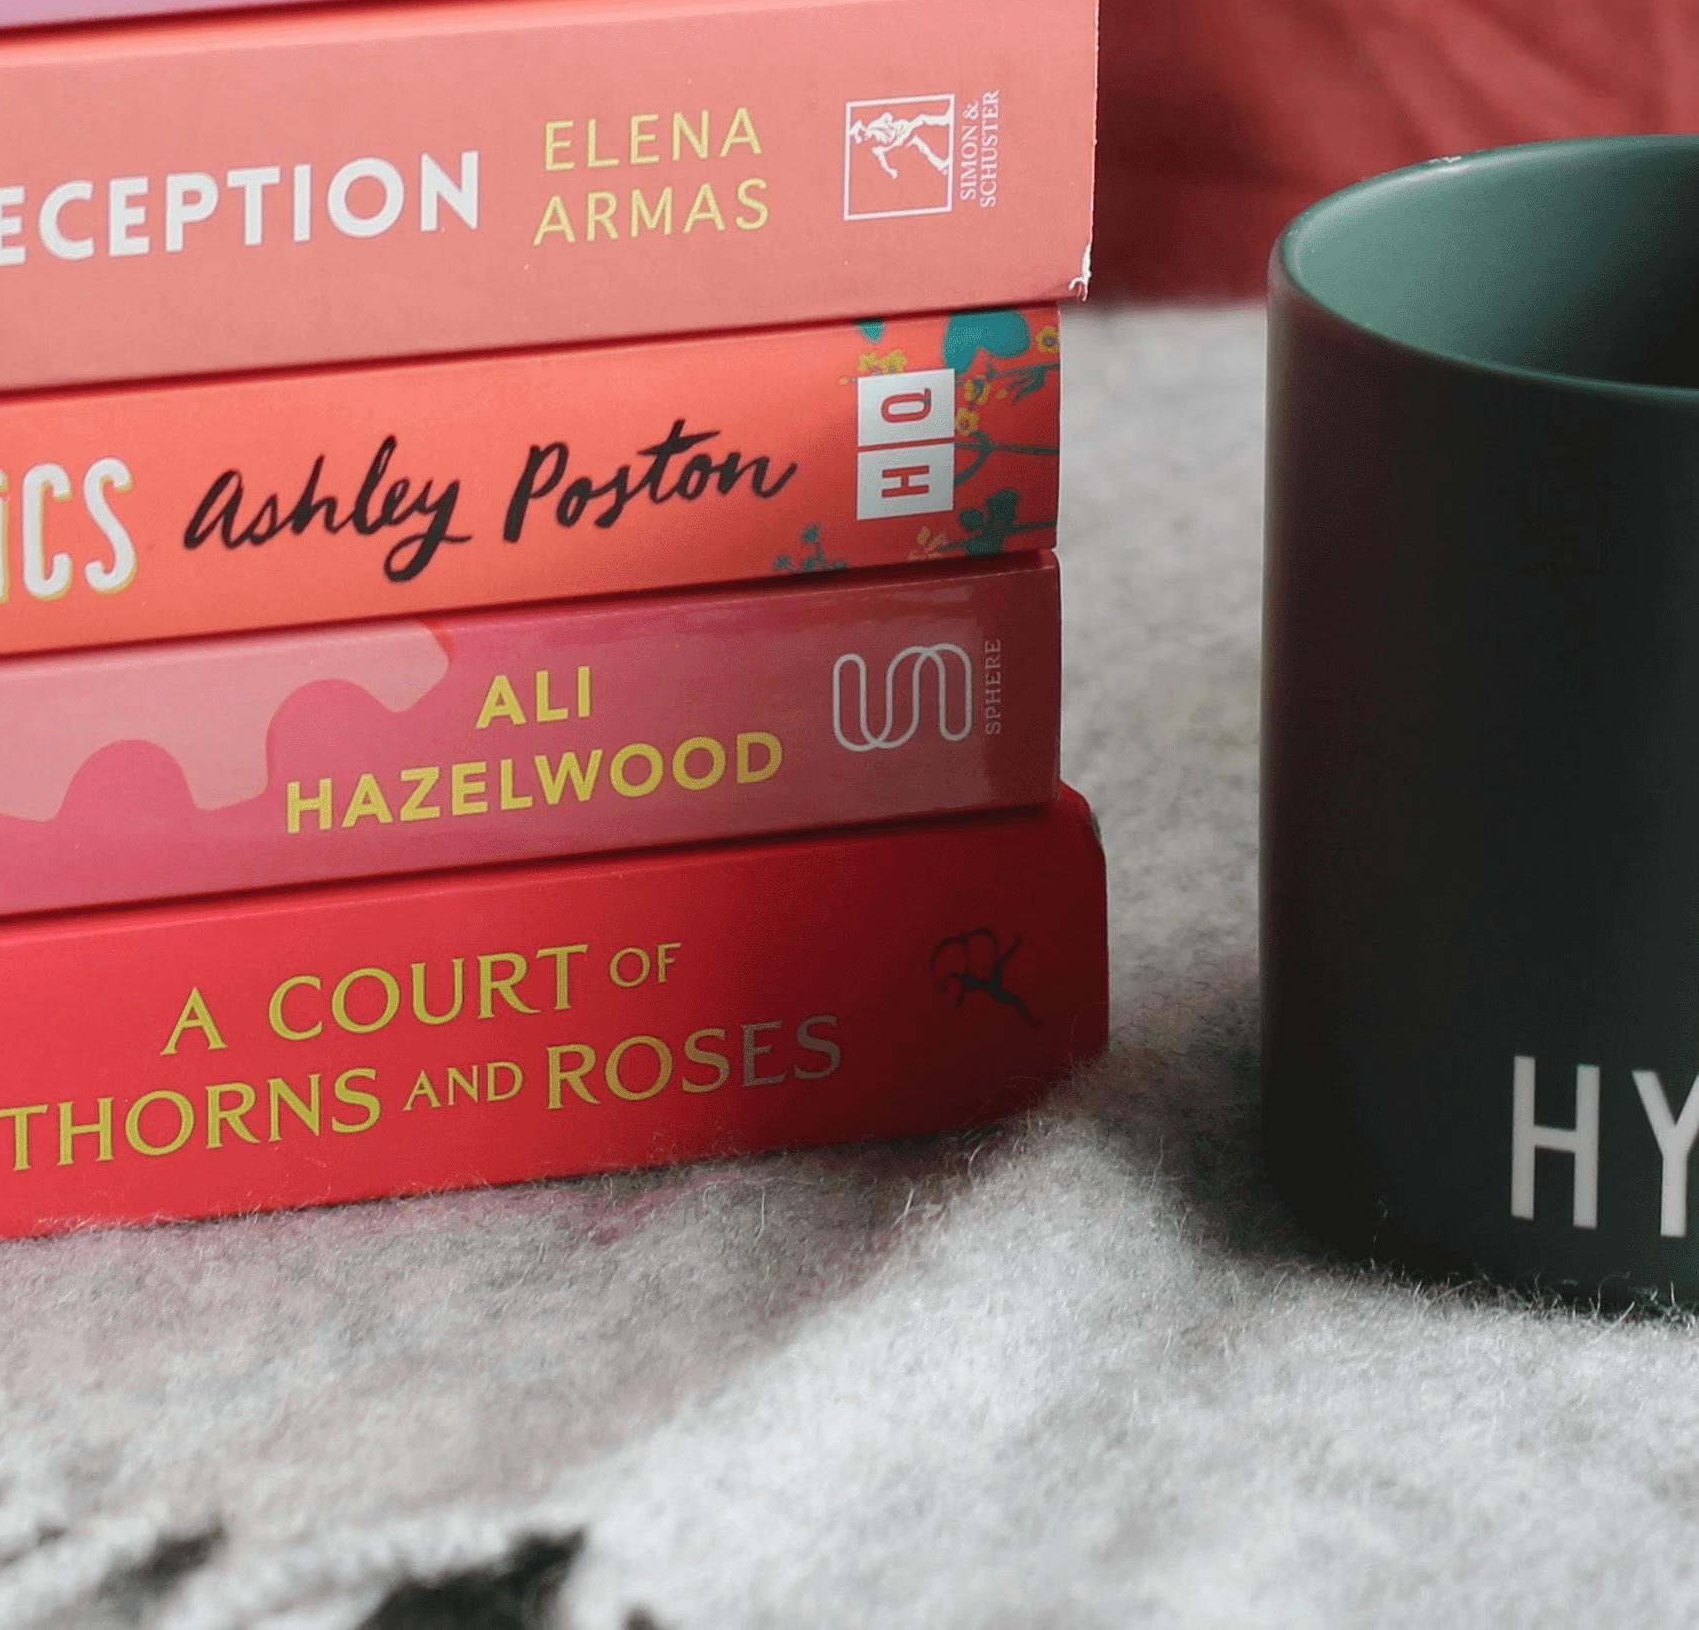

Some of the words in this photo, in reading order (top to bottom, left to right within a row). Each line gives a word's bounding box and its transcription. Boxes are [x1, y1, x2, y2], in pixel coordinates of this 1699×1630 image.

[544, 105, 764, 173] ELENA
[962, 100, 979, 121] &
[980, 89, 1000, 208] SCHUSTER
[960, 125, 978, 200] SIMON
[533, 178, 771, 247] ARMAS
[183, 434, 472, 582] Ashley
[503, 419, 797, 543] Poston
[475, 665, 592, 730] ALI
[984, 638, 1003, 737] SPHERE
[286, 730, 784, 835] HAZELWOOD
[159, 985, 229, 1057] A
[265, 941, 590, 1042] COURT
[608, 940, 683, 989] OF
[402, 1059, 524, 1113] AND
[545, 1014, 843, 1112] ROSES
[1511, 1054, 1699, 1238] HY
